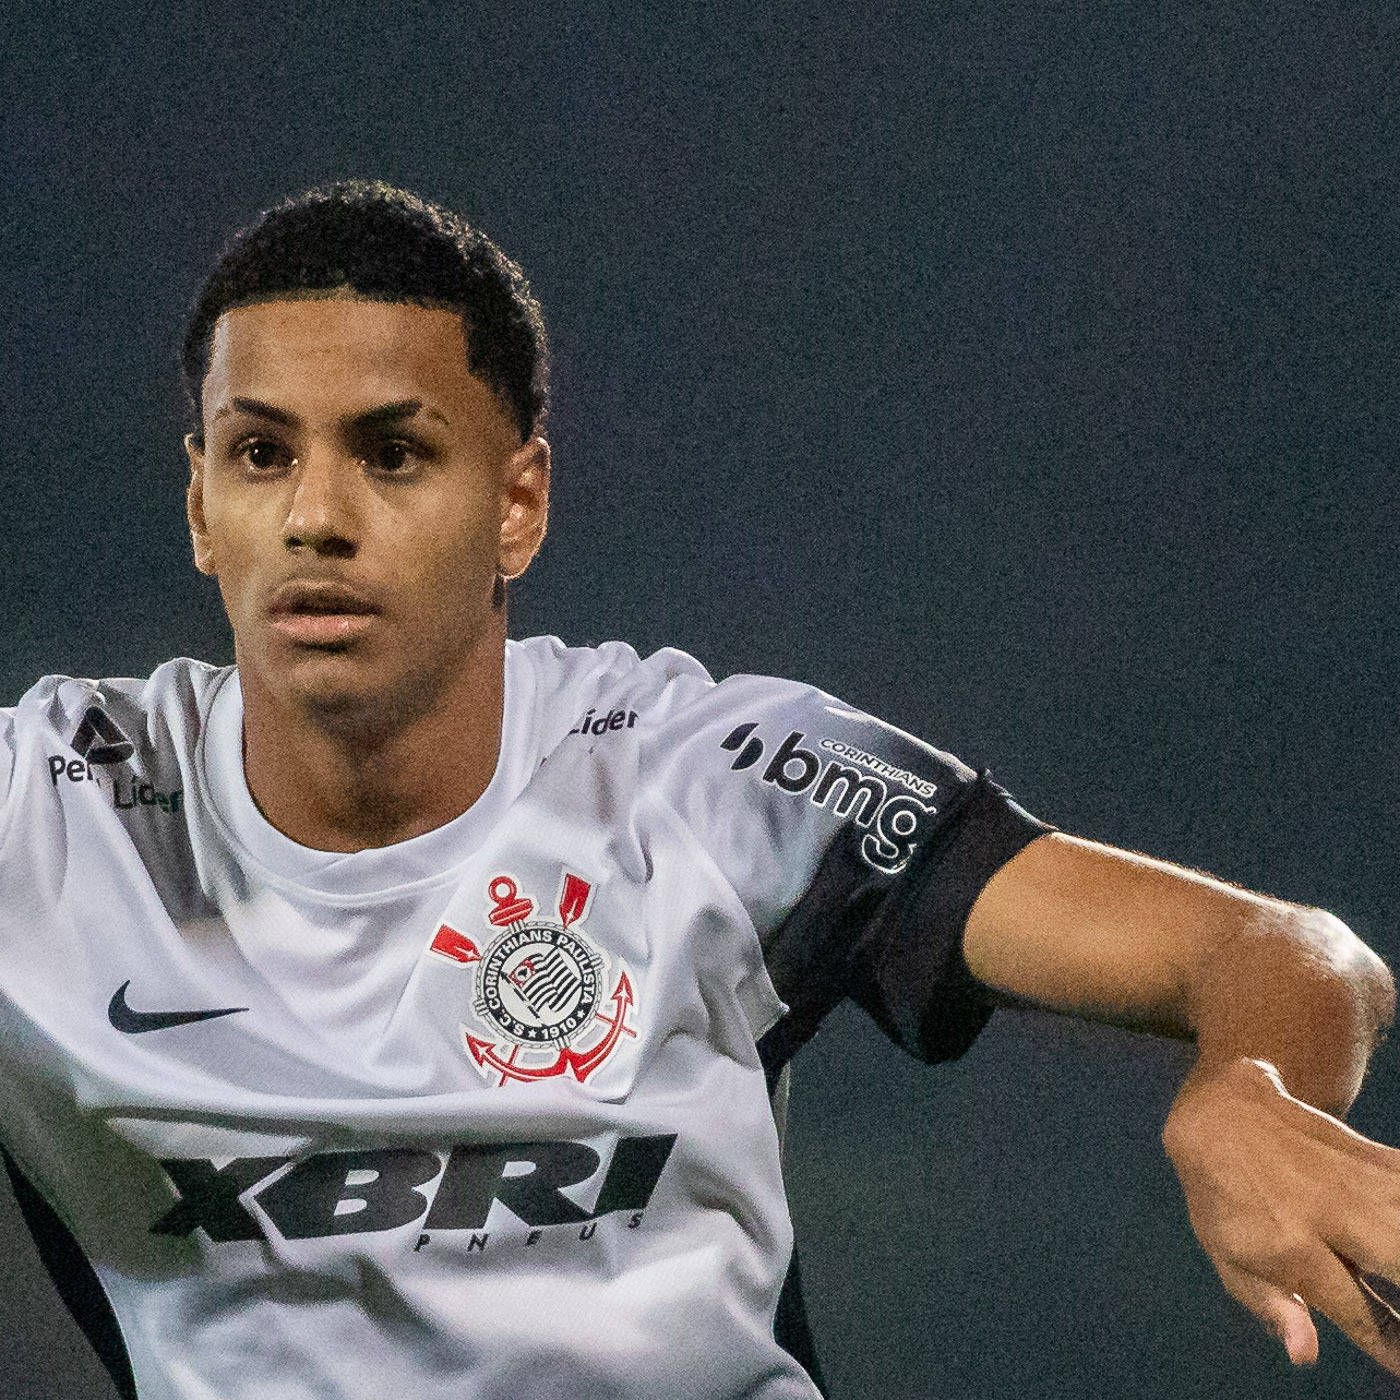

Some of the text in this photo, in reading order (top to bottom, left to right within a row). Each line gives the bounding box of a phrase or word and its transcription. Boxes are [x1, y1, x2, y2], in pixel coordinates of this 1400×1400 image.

[762, 730, 938, 874] bmg
[819, 738, 938, 798] CORINTHIANS
[484, 930, 553, 1009] CORINTHIANS
[555, 936, 596, 1003] PAULISTA
[541, 1016, 577, 1040] 1910
[149, 1132, 678, 1243] XBRI
